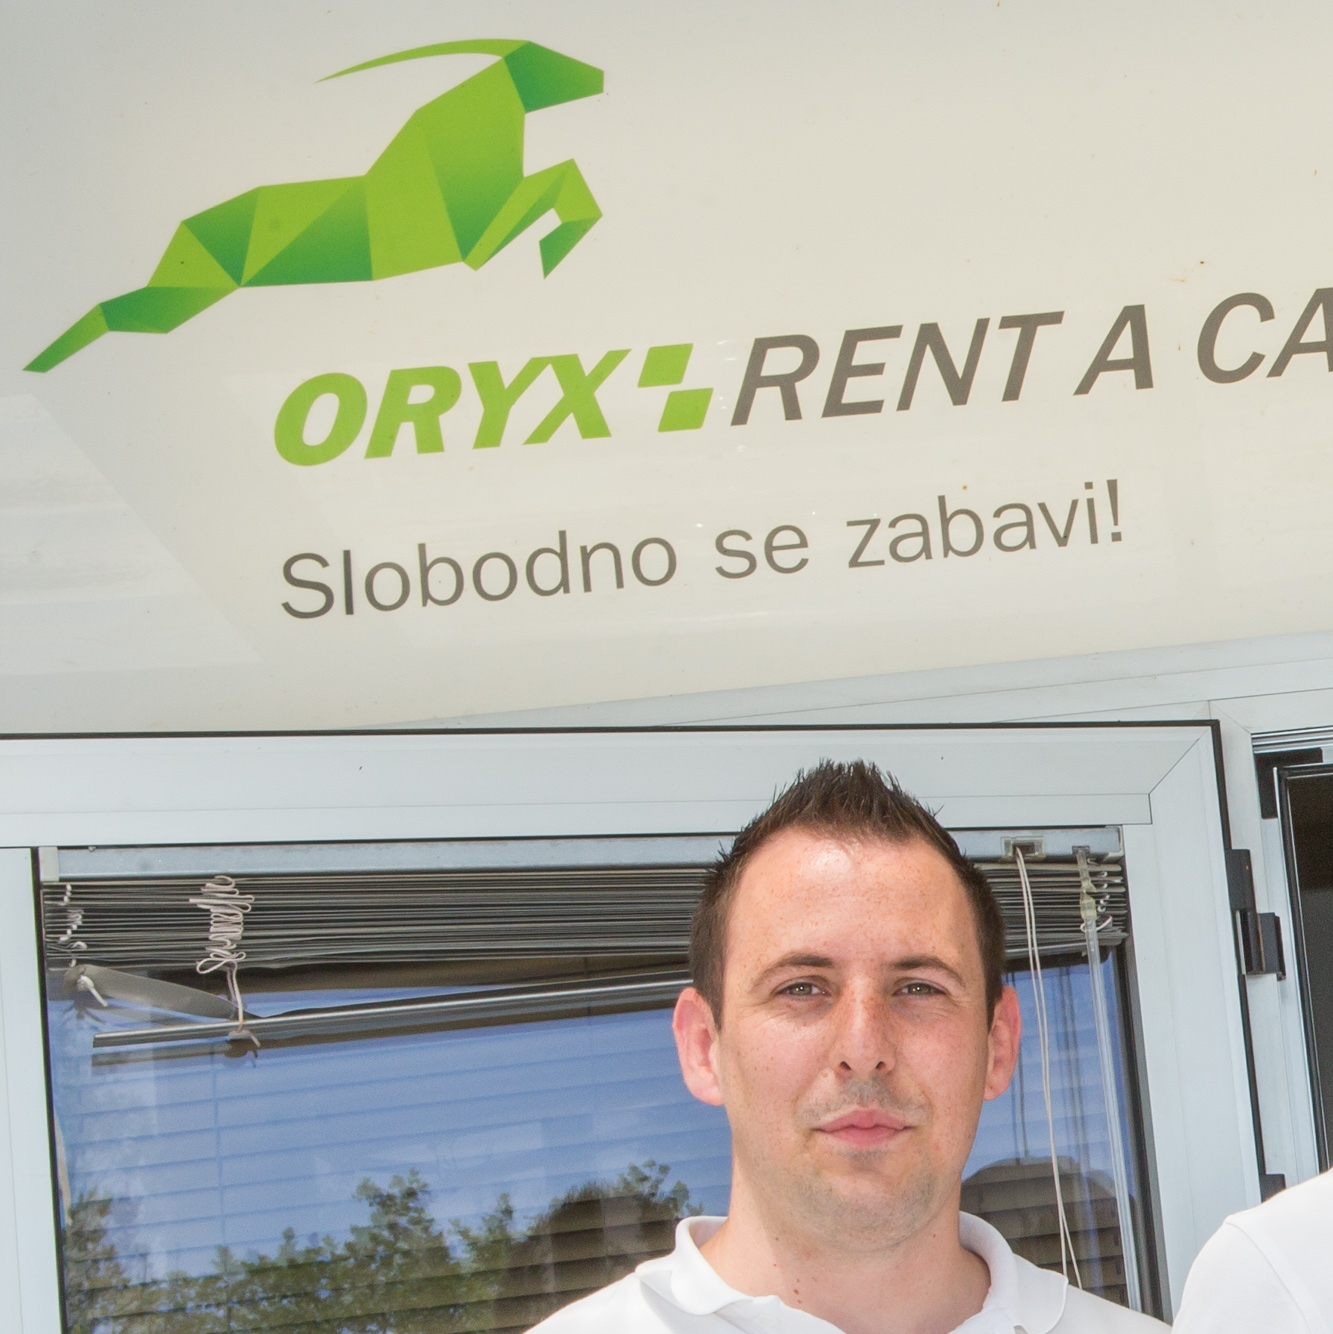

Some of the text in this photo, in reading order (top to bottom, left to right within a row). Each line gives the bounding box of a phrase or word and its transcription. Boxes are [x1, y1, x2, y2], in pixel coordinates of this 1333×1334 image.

[273, 348, 631, 467] ORYX
[730, 311, 1065, 427] RENT
[1074, 304, 1155, 396] A
[280, 479, 1123, 620] Slobodno se zabavi!
